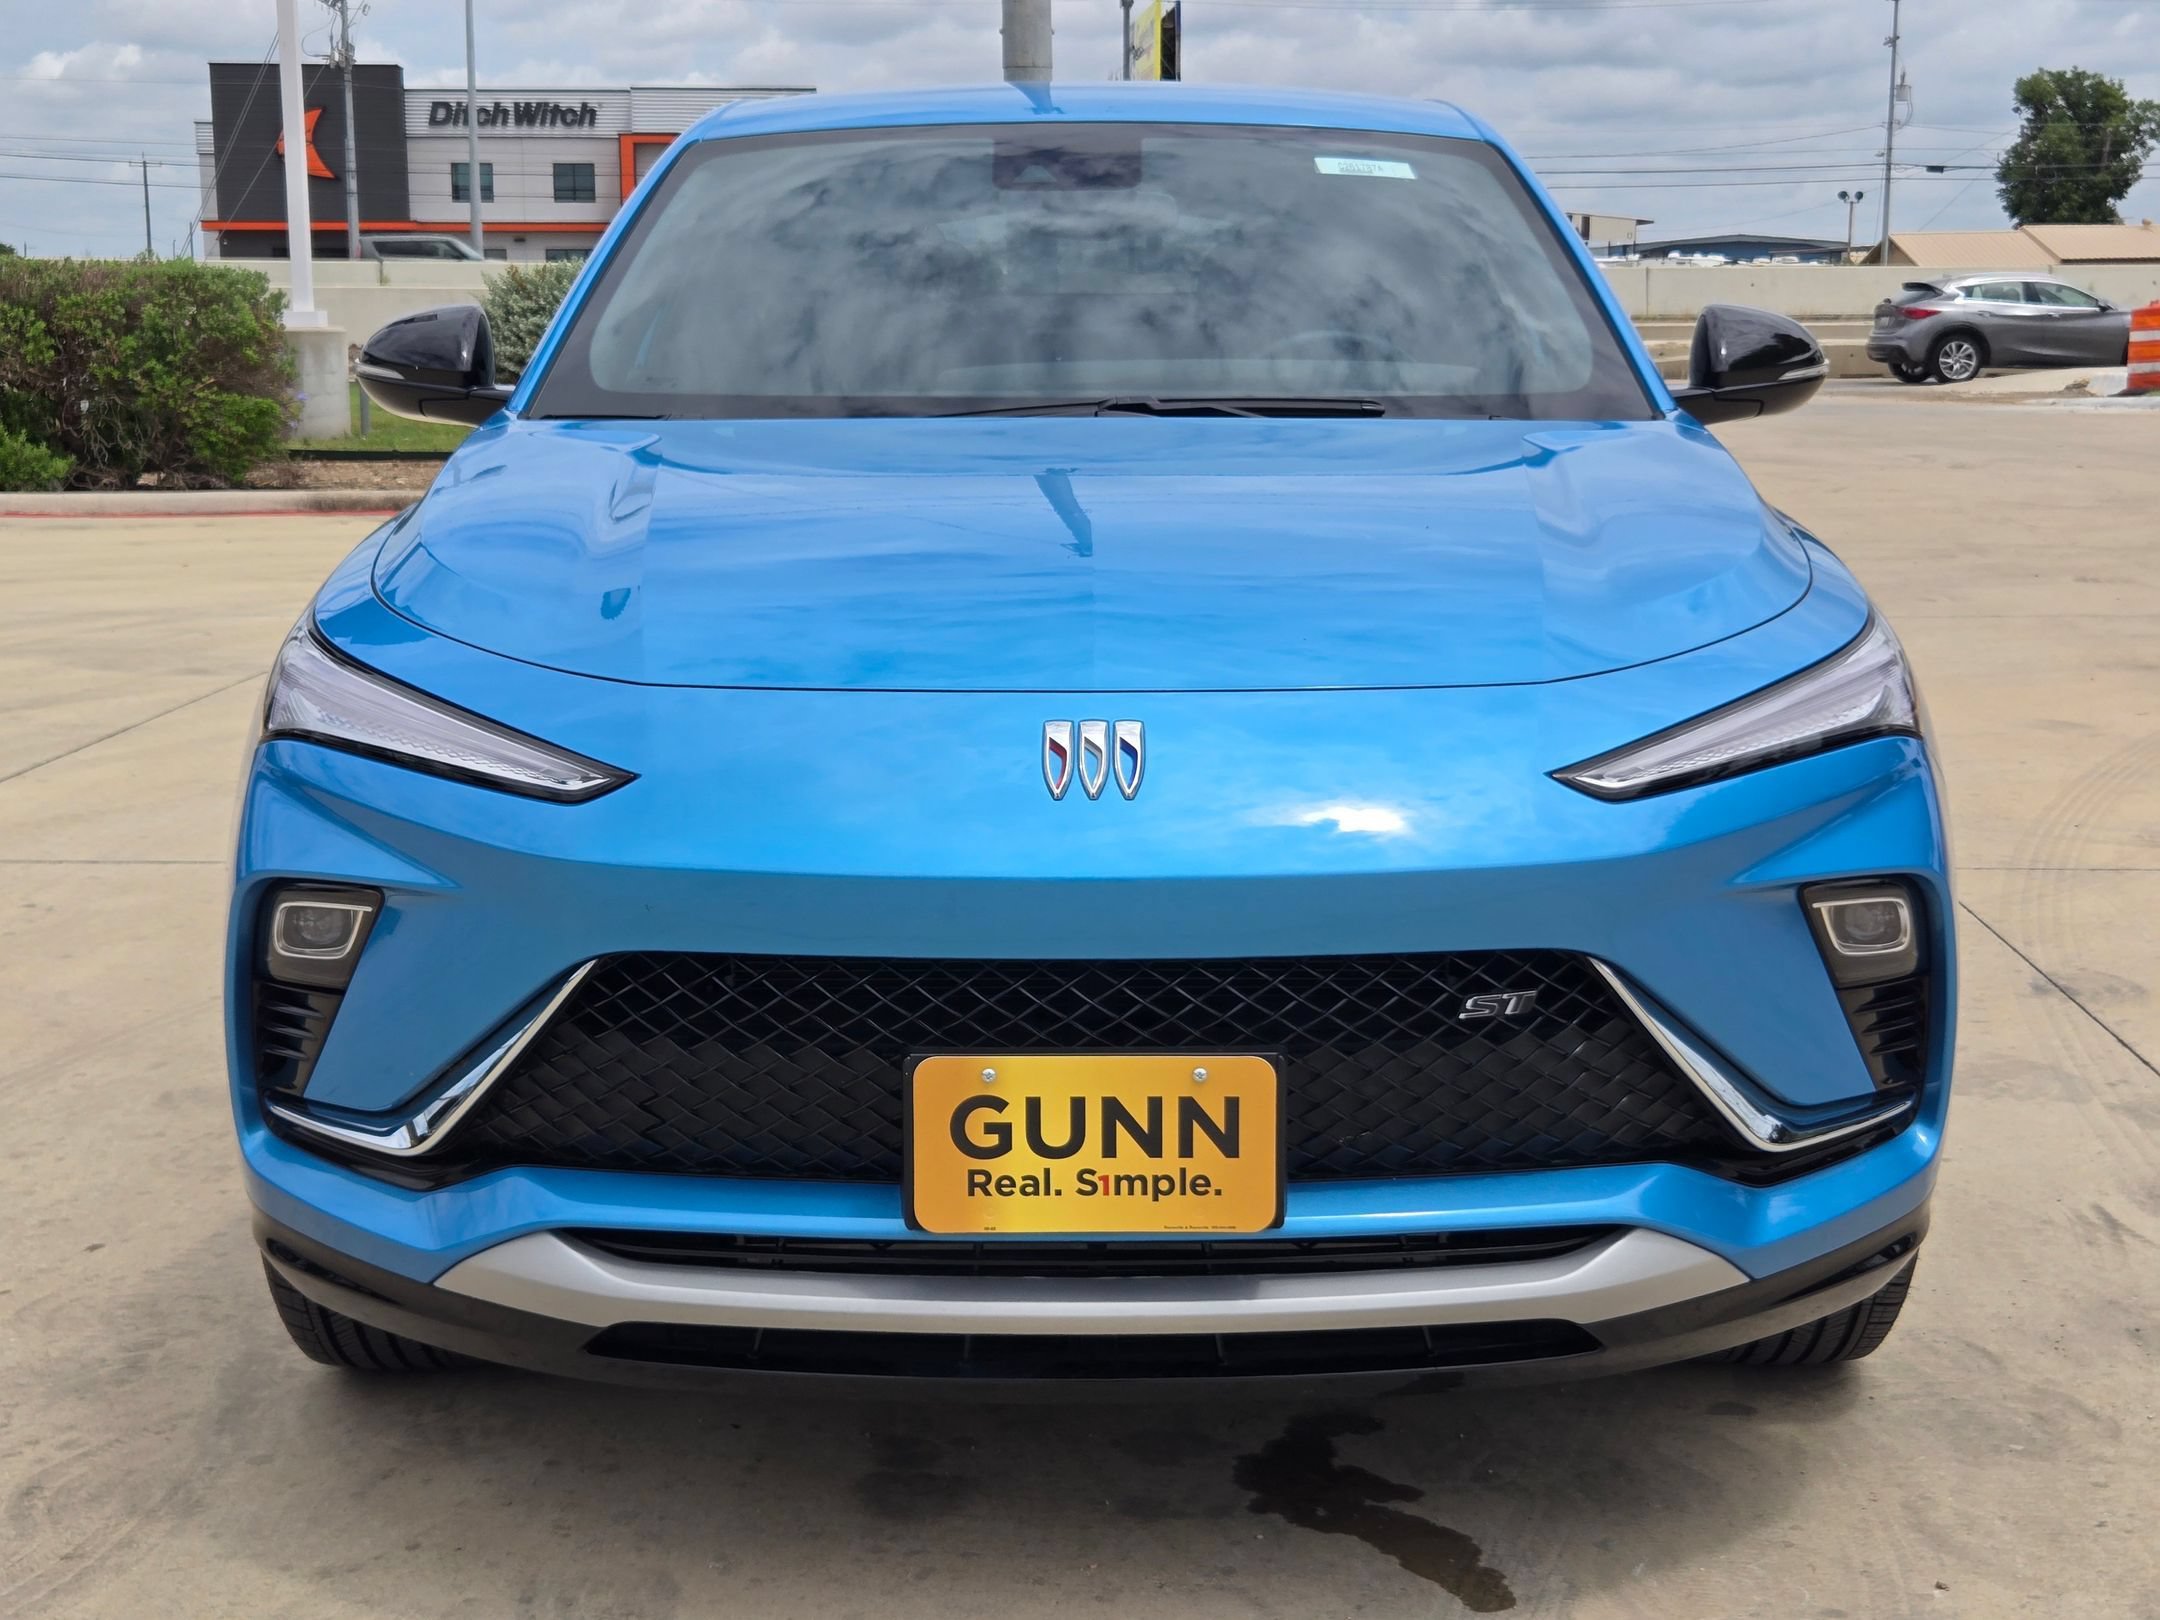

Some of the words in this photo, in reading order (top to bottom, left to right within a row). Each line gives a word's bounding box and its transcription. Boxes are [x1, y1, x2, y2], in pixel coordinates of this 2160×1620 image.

[429, 101, 509, 127] Ditch
[513, 101, 597, 127] Witch
[1458, 990, 1537, 1019] ST
[950, 1094, 1240, 1160] GUNN
[967, 1168, 1062, 1197] Real.
